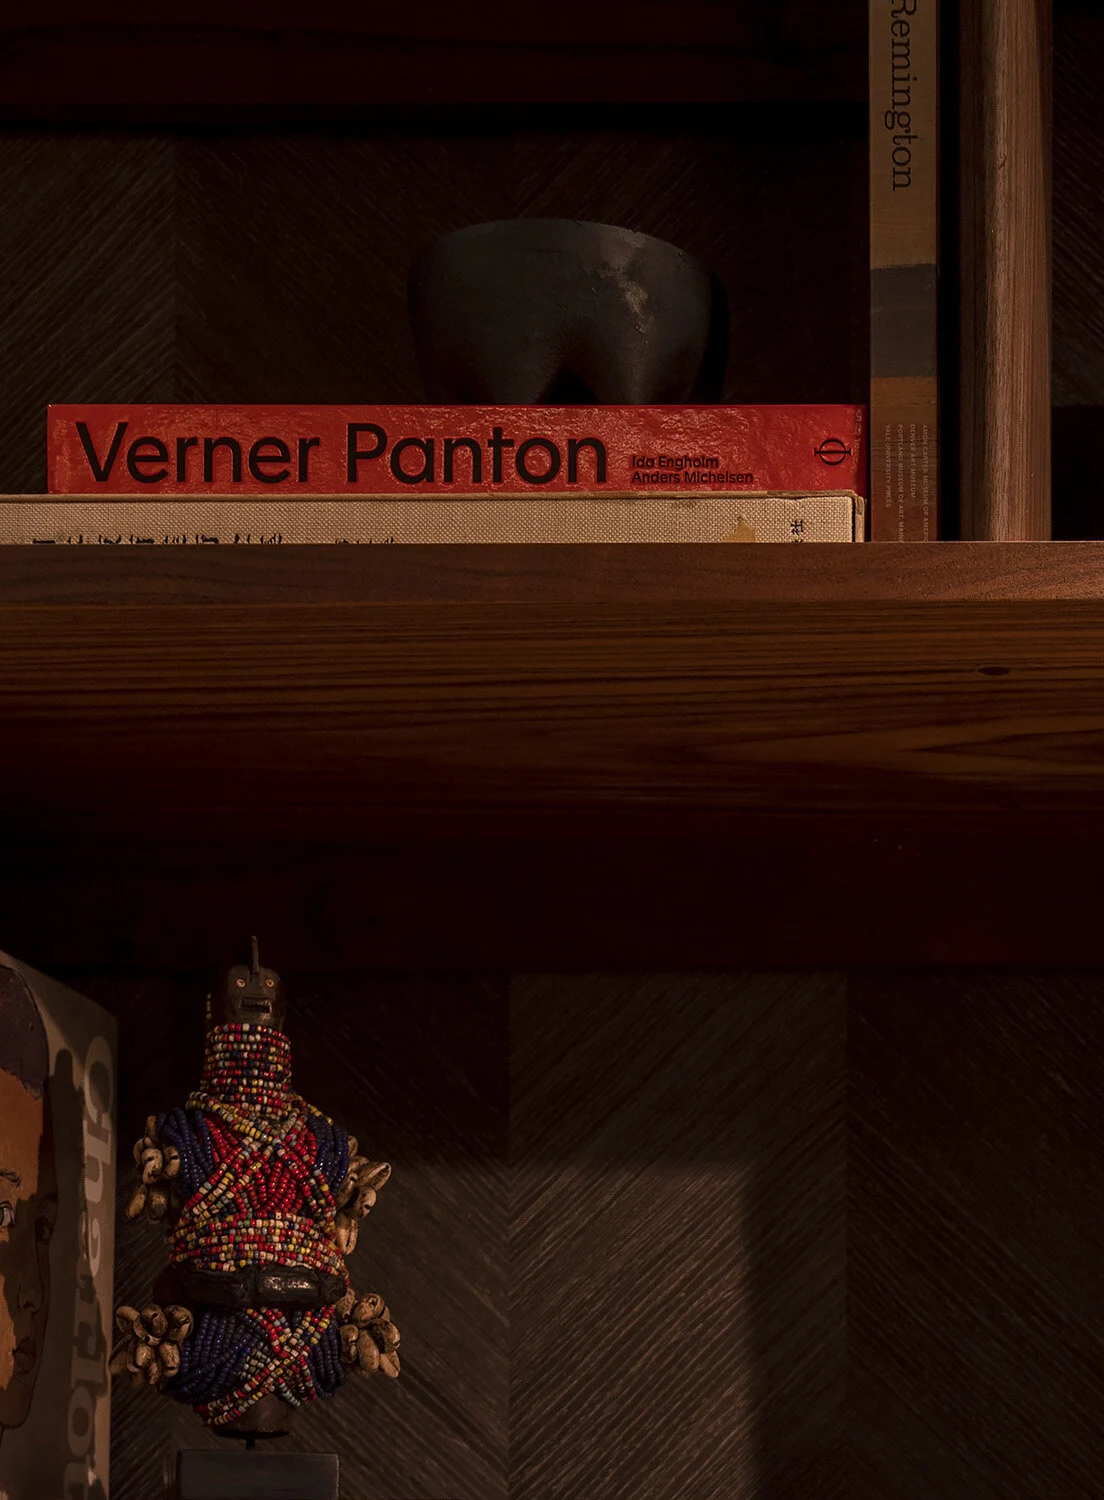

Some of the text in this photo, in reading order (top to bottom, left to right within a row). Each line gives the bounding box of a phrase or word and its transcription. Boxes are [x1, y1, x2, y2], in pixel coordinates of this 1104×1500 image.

[884, 0, 919, 192] Remington
[75, 421, 607, 485] Verner Panton
[631, 455, 719, 471] Ida Engholm
[631, 470, 754, 484] Anders Michelsen
[897, 494, 904, 504] OF
[922, 506, 929, 516] OF
